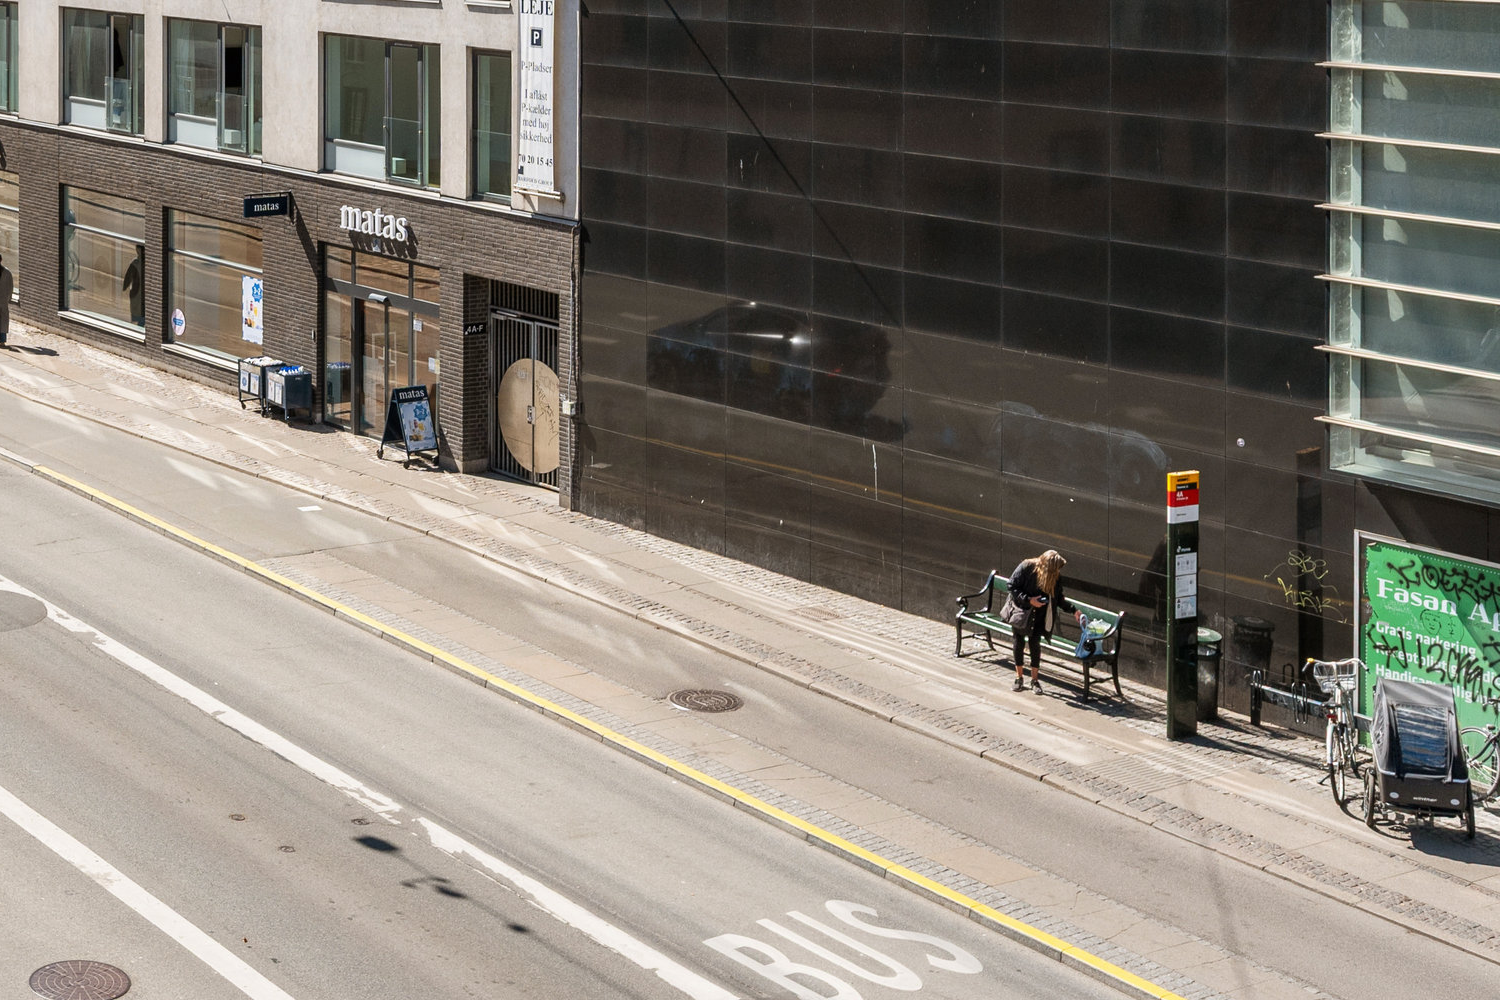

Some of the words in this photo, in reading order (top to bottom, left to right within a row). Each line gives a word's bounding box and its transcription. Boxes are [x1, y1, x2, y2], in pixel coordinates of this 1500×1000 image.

[520, 0, 553, 16] LEJE
[533, 31, 540, 44] P
[521, 61, 552, 73] P-Pladser
[522, 117, 537, 127] med
[527, 154, 535, 164] 20
[536, 156, 544, 166] 15
[545, 158, 553, 168] 45
[253, 201, 280, 212] matas
[340, 205, 409, 242] matas
[398, 389, 425, 400] matas
[1376, 577, 1458, 617] Fasan
[1376, 620, 1412, 641] Gratis
[1415, 633, 1477, 660] parkering
[702, 900, 984, 1000] BUS
